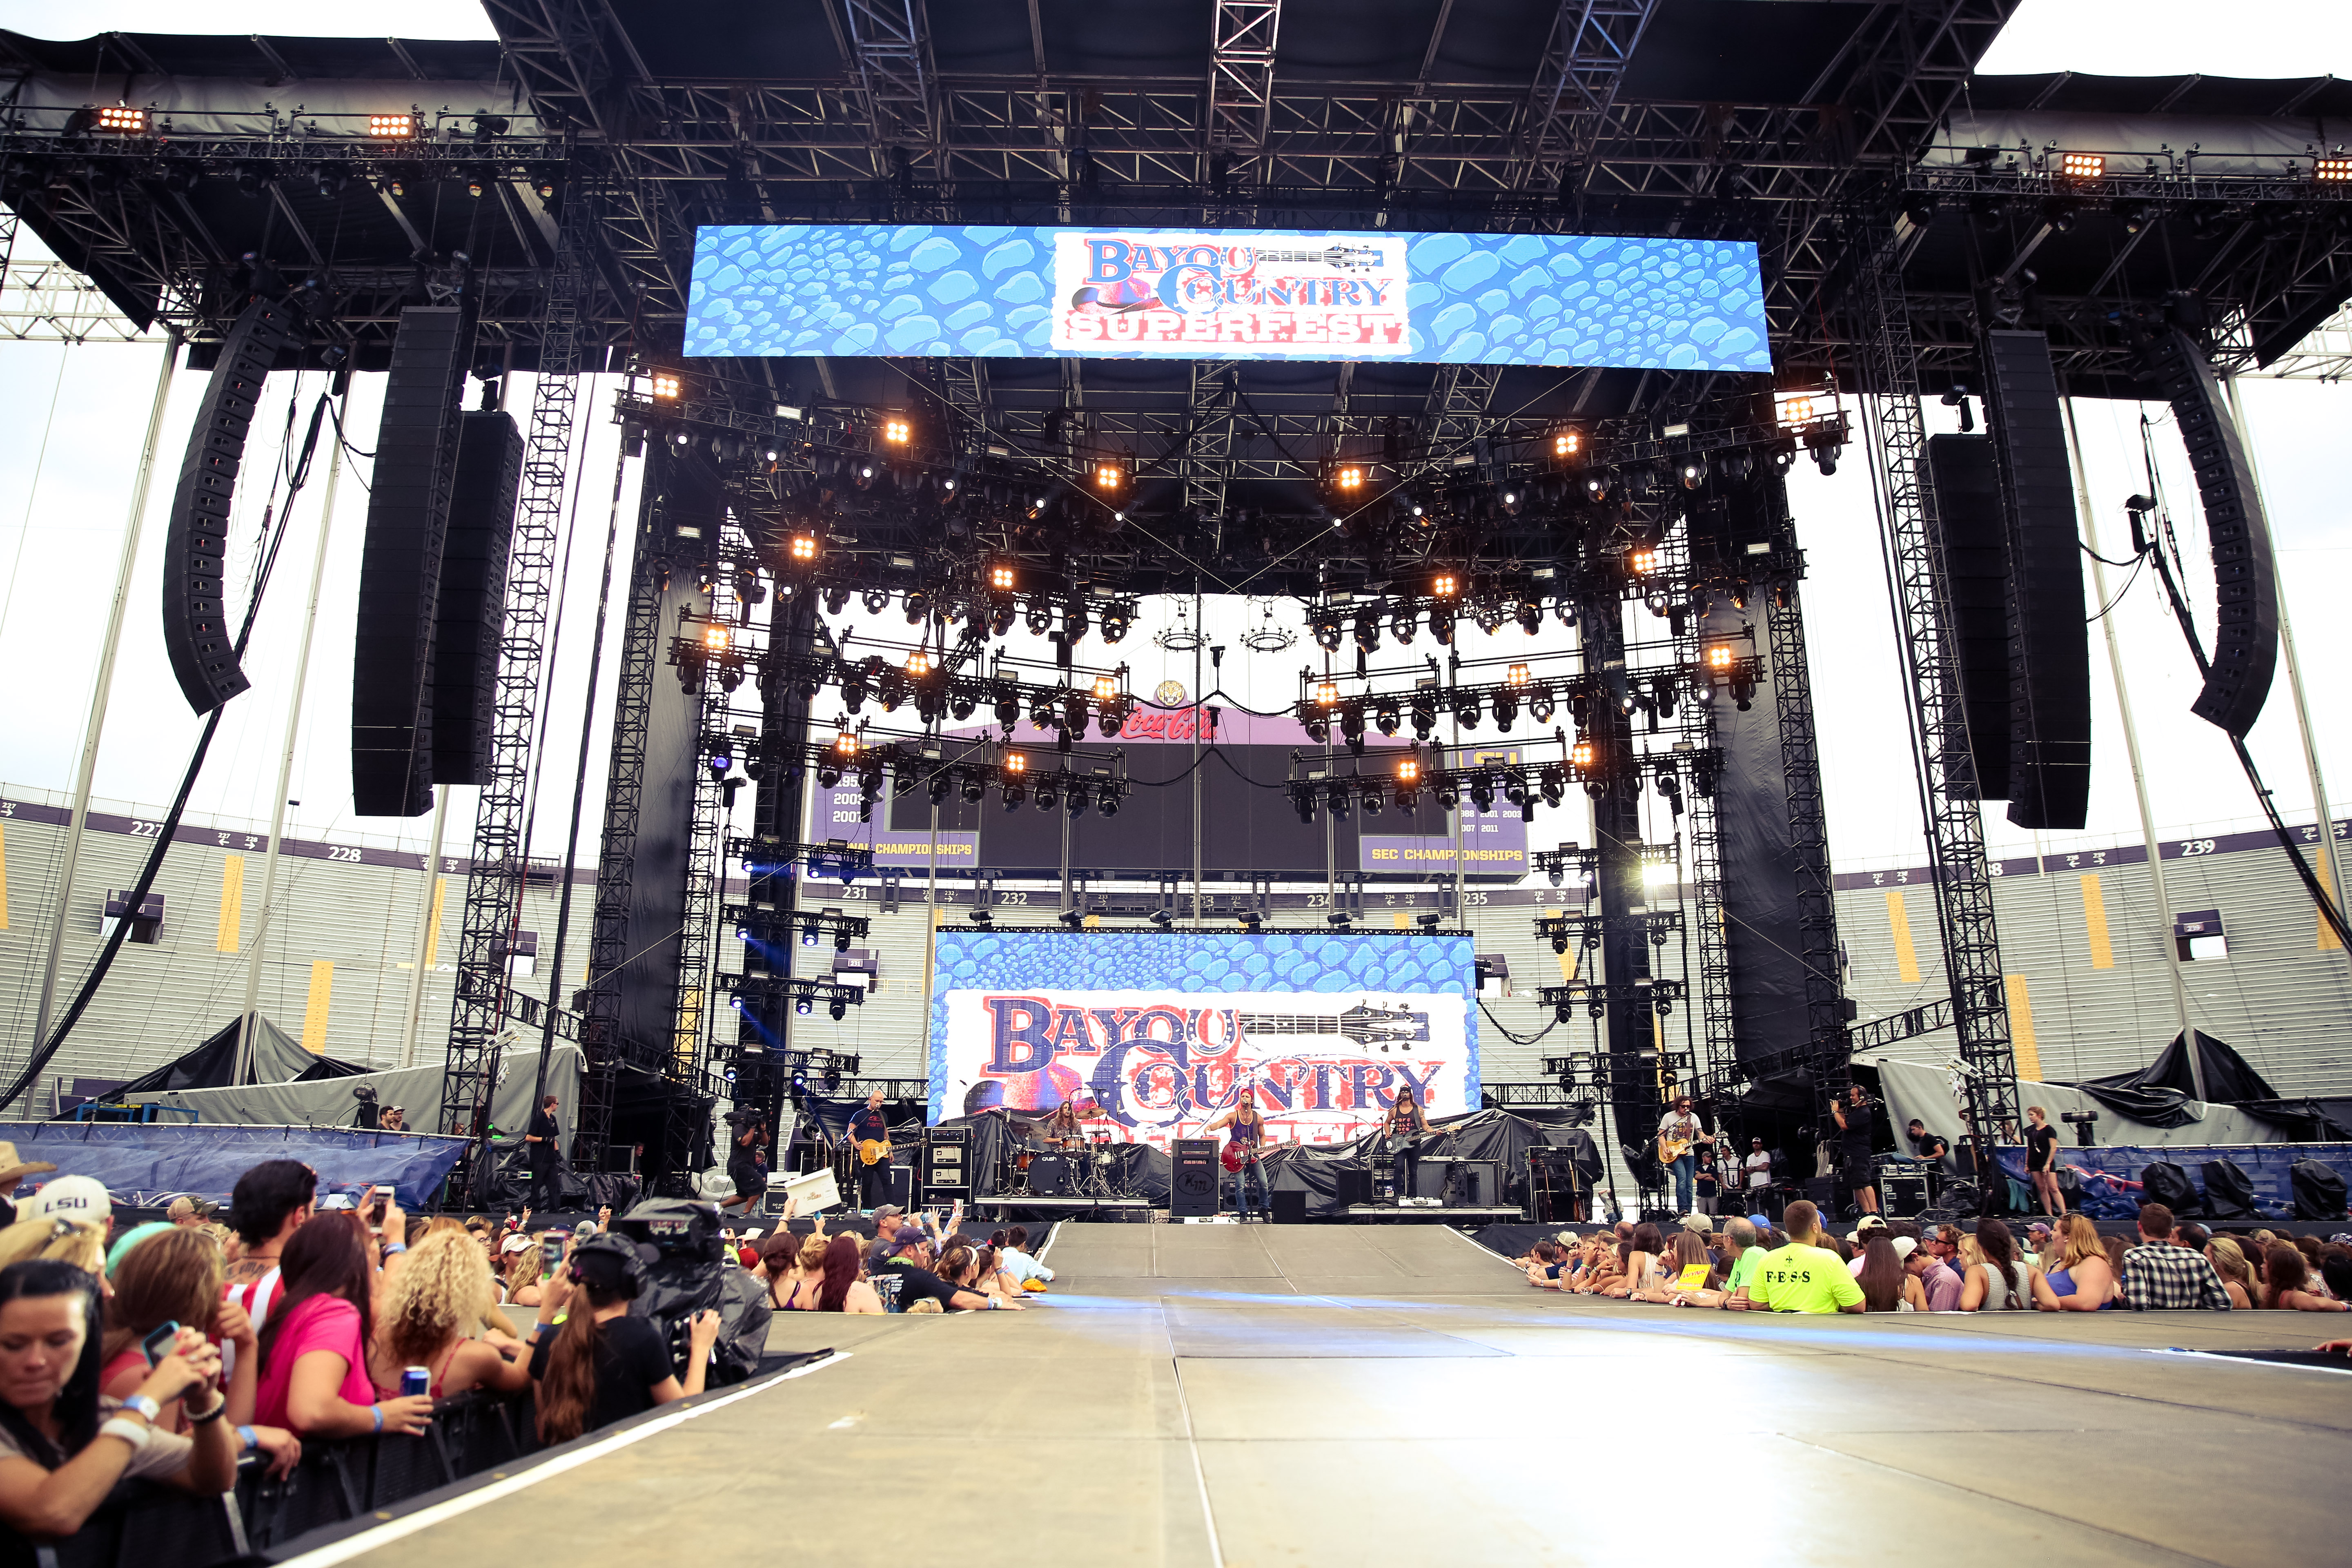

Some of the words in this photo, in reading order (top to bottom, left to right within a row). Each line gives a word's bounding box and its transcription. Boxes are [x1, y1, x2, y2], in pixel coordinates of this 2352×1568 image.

[1084, 238, 1256, 285] BAYOU
[1157, 263, 1393, 315] COUNTRY
[1066, 310, 1404, 344] SUPERFEST
[835, 775, 860, 787] 195
[130, 820, 165, 838] 227
[1481, 824, 1499, 833] 2011
[328, 846, 362, 863] 228
[1372, 849, 1399, 860] SEC
[2180, 839, 2216, 857] 239
[842, 886, 868, 899] 231
[1001, 892, 1027, 905] 232
[1464, 892, 1488, 905] 235
[1307, 895, 1330, 907] 234
[982, 996, 1240, 1077] BAYOU
[1087, 1039, 1446, 1129] COUNTRY
[45, 1197, 88, 1213] LSU
[1683, 1270, 1706, 1278] WYNK
